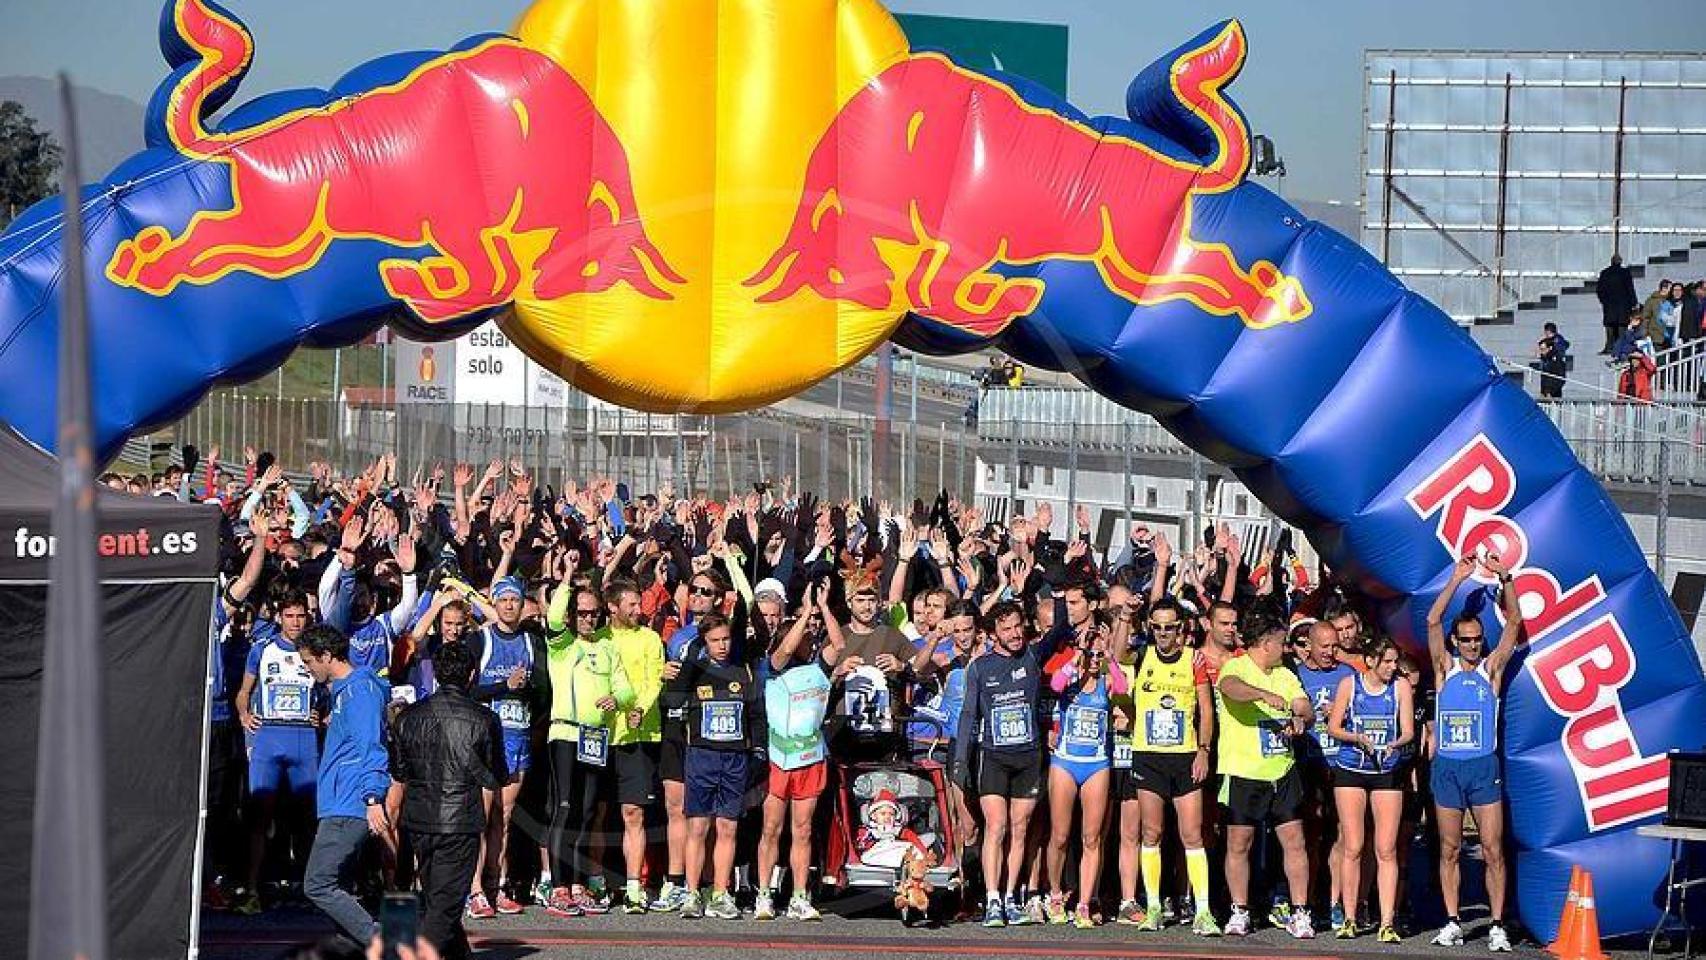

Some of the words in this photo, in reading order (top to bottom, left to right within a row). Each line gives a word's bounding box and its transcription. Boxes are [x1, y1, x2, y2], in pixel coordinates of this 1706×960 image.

[467, 354, 503, 374] solo
[407, 385, 448, 400] RACE
[711, 716, 736, 733] 409
[1073, 719, 1099, 738] 355
[1450, 725, 1471, 742] 141
